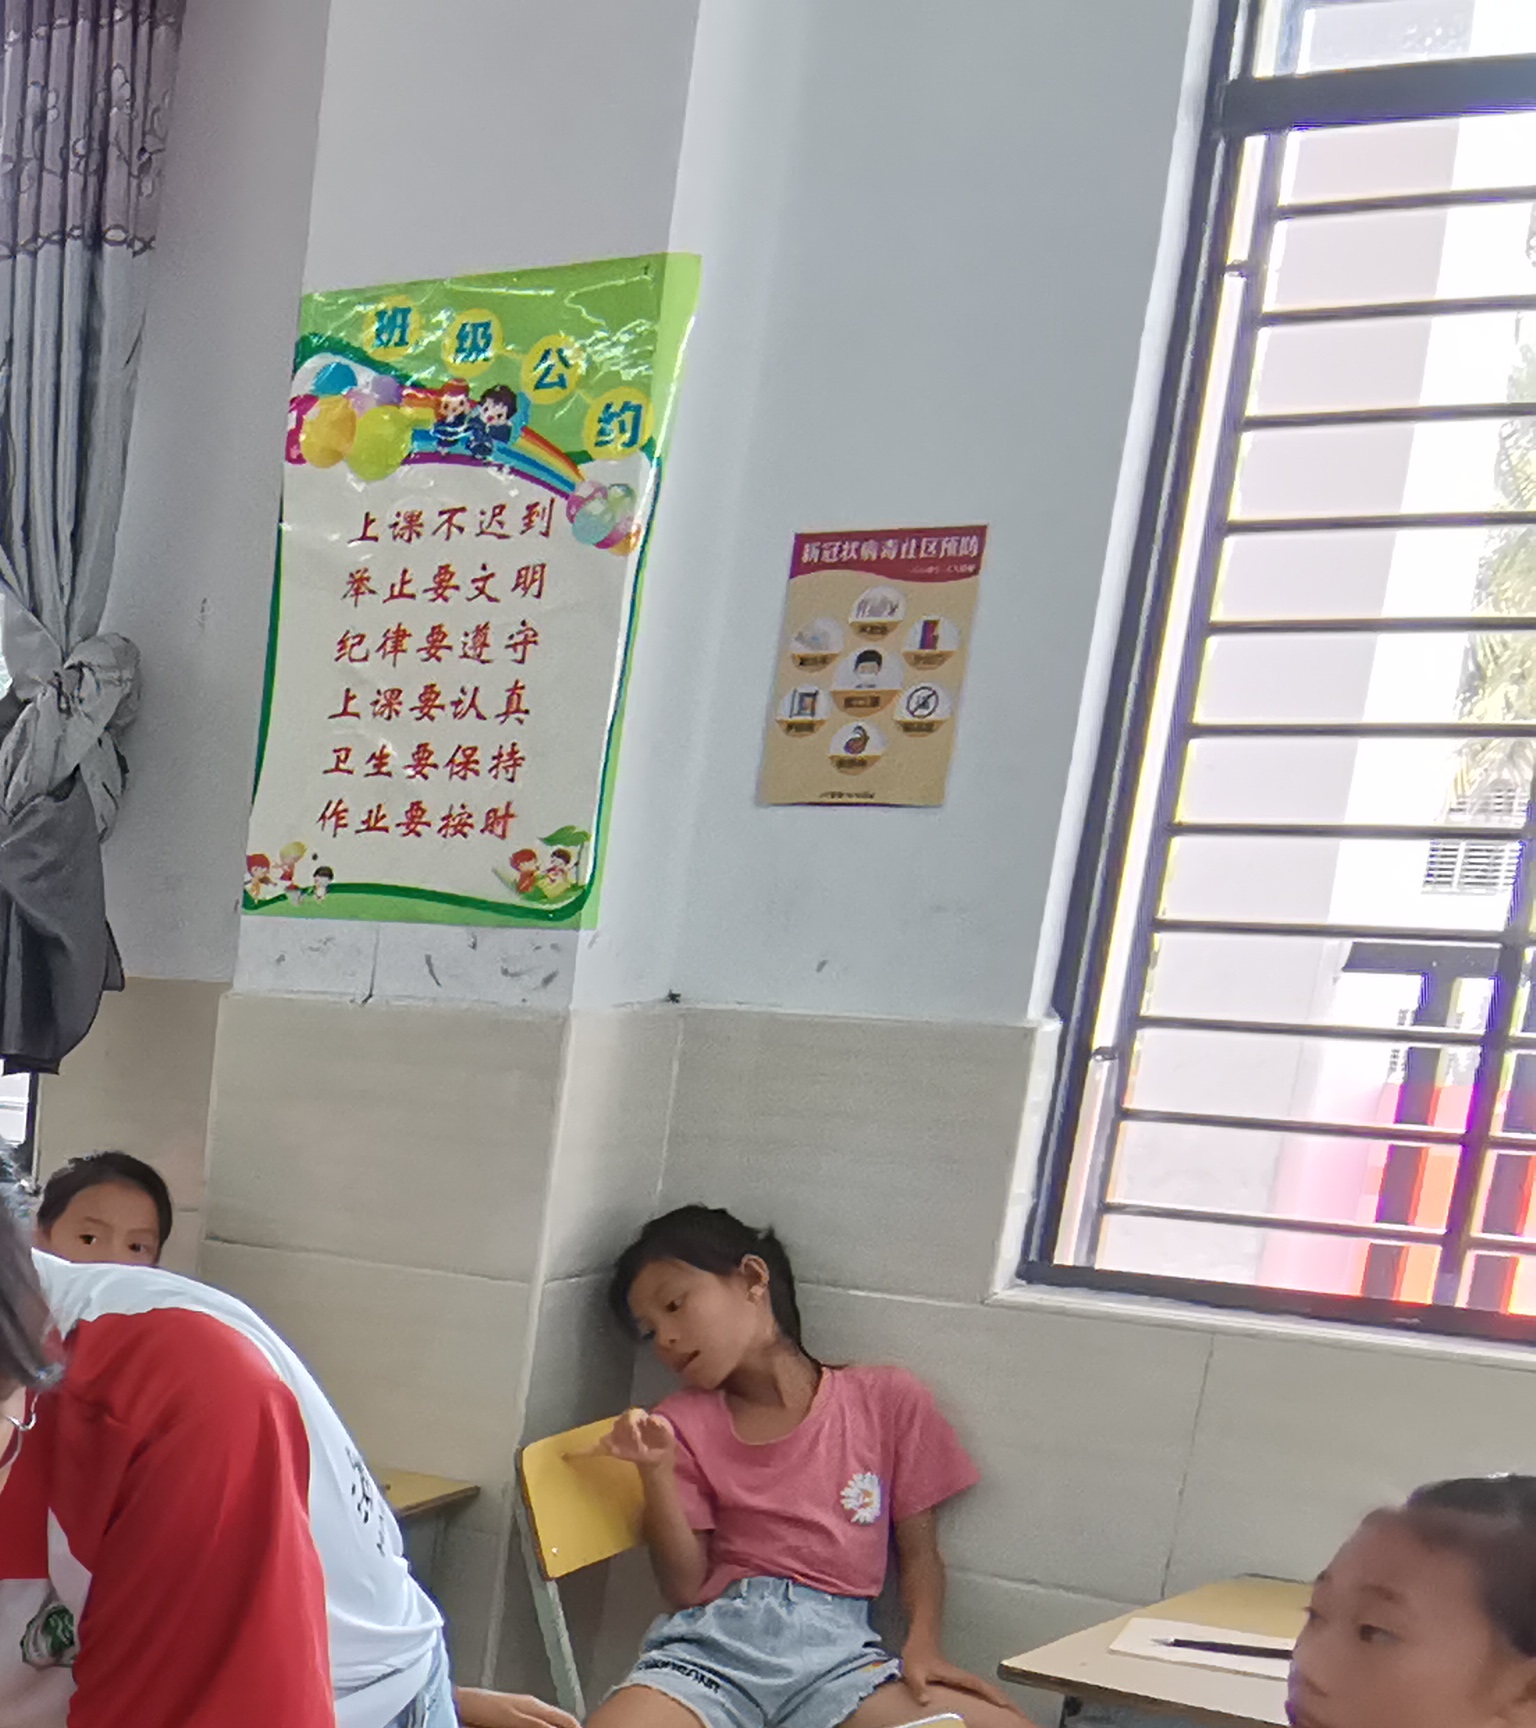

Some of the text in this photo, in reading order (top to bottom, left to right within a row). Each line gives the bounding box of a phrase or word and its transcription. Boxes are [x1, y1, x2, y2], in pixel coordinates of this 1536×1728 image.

[374, 304, 644, 449] 班级公约
[347, 499, 554, 545] 上课不迟到
[801, 536, 978, 563] 新冠状病毒社区预防
[342, 562, 547, 606] 举止要文明
[334, 619, 540, 666] 纪律要遵守
[328, 680, 531, 724] 上课要认真
[322, 741, 527, 783] 卫生要保持
[317, 800, 517, 840] 作业要按时
